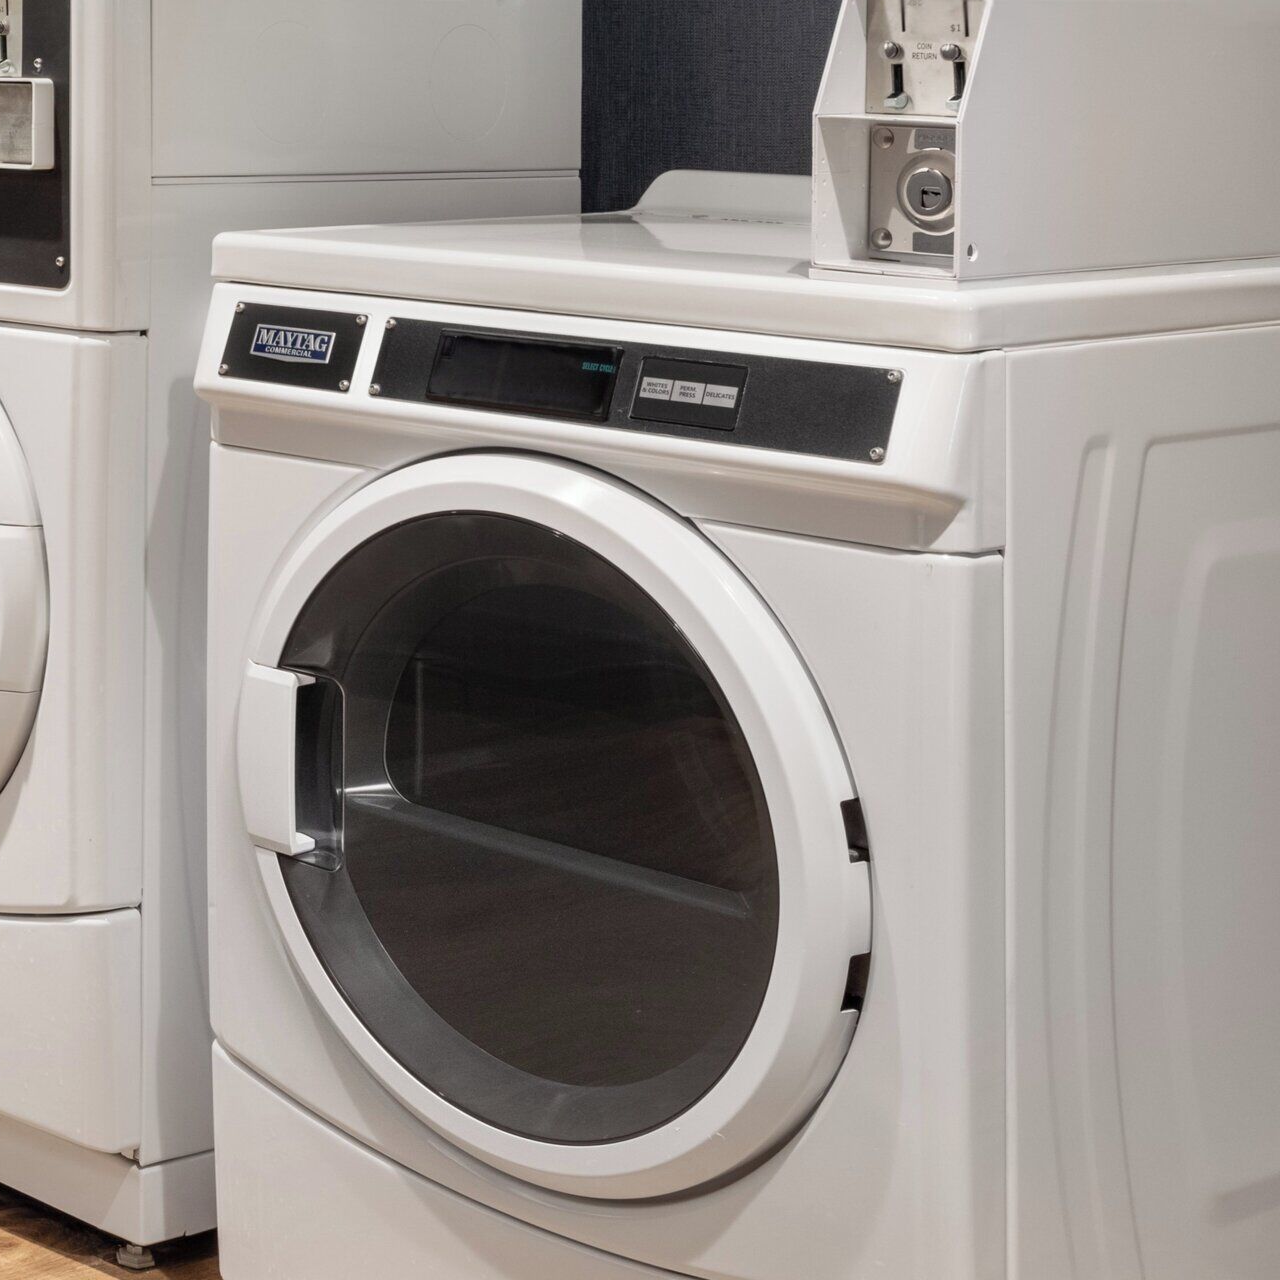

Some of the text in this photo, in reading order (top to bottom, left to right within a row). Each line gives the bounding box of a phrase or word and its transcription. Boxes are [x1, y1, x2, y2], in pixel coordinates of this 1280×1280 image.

[950, 24, 961, 32] $1
[912, 52, 938, 61] RETURN
[256, 328, 329, 352] MAYTAG
[265, 345, 312, 358] COMMERCIAL
[581, 361, 599, 371] SELECT
[646, 381, 668, 389] WHITES
[647, 388, 670, 396] COLORS
[679, 391, 696, 399] PRESS
[705, 392, 735, 401] DELICATES
